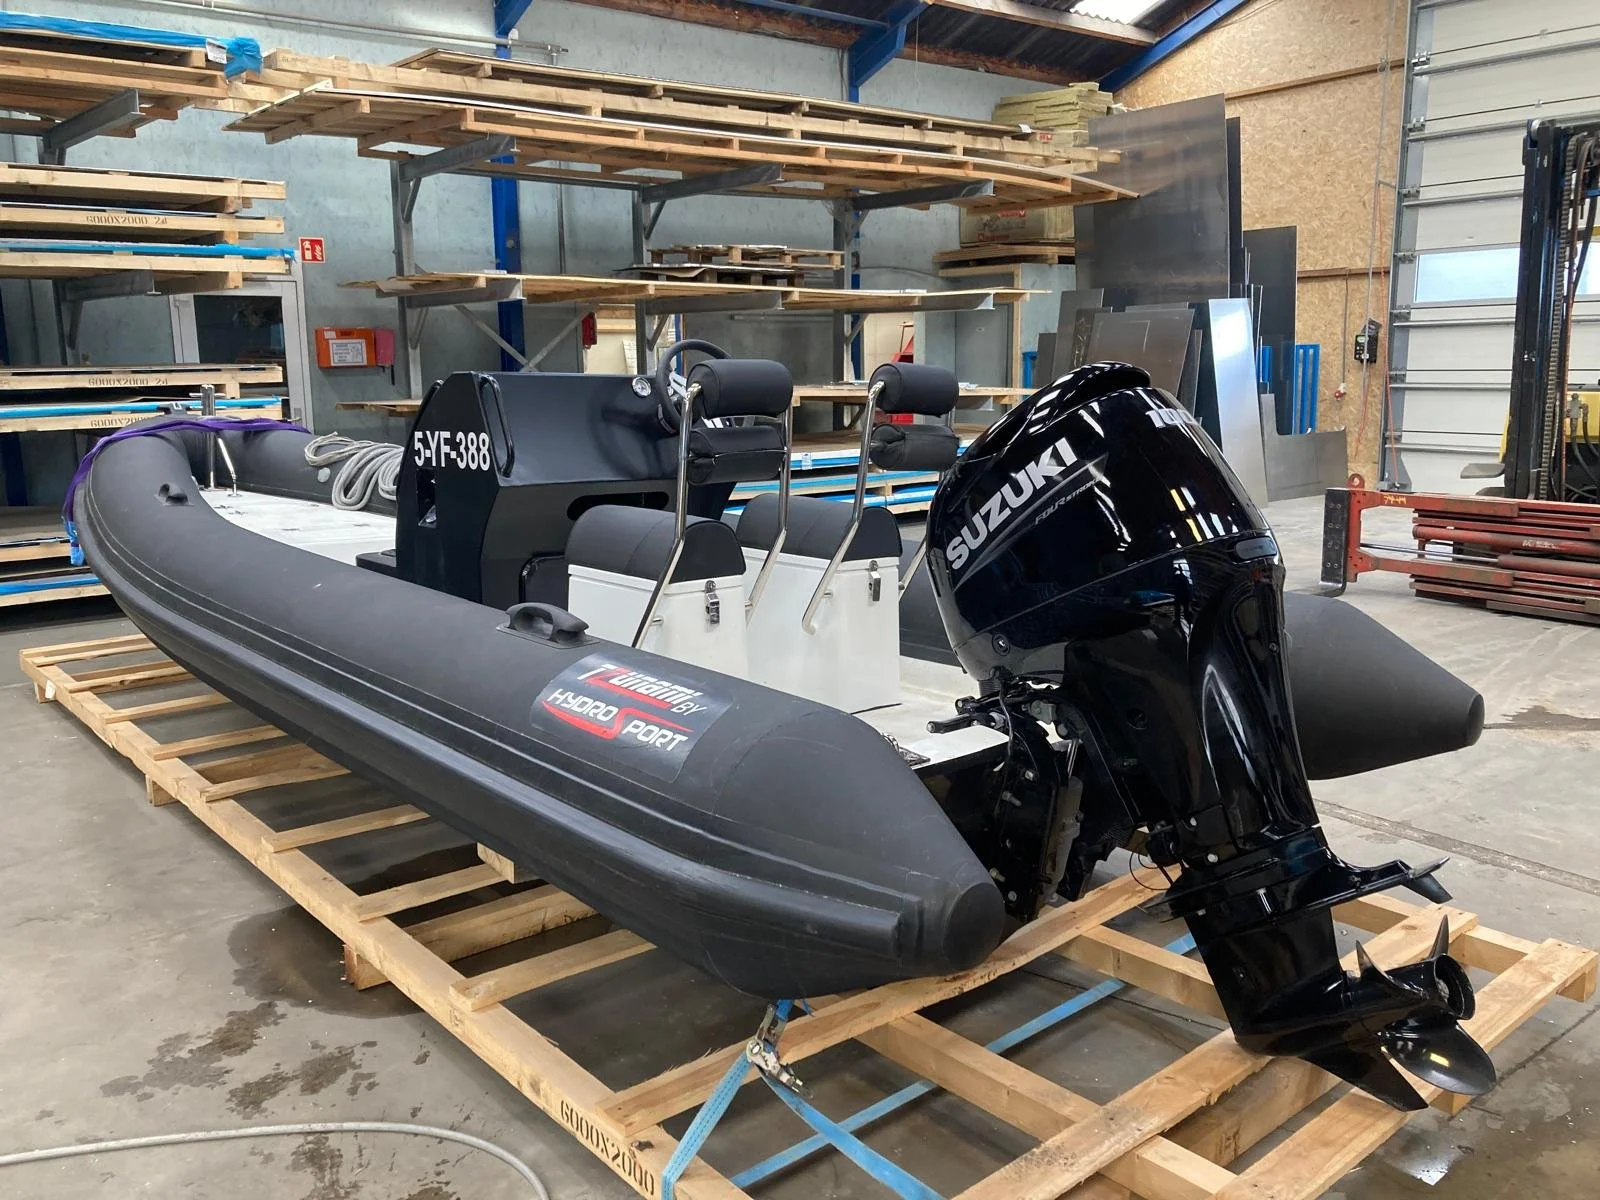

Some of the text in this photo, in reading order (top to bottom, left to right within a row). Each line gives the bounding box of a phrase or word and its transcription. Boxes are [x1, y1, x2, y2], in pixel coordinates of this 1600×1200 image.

[414, 430, 491, 471] 5-YF-388
[946, 437, 1078, 570] SUZUKI
[670, 701, 708, 716] BY
[561, 1100, 654, 1196] 6000X2000
